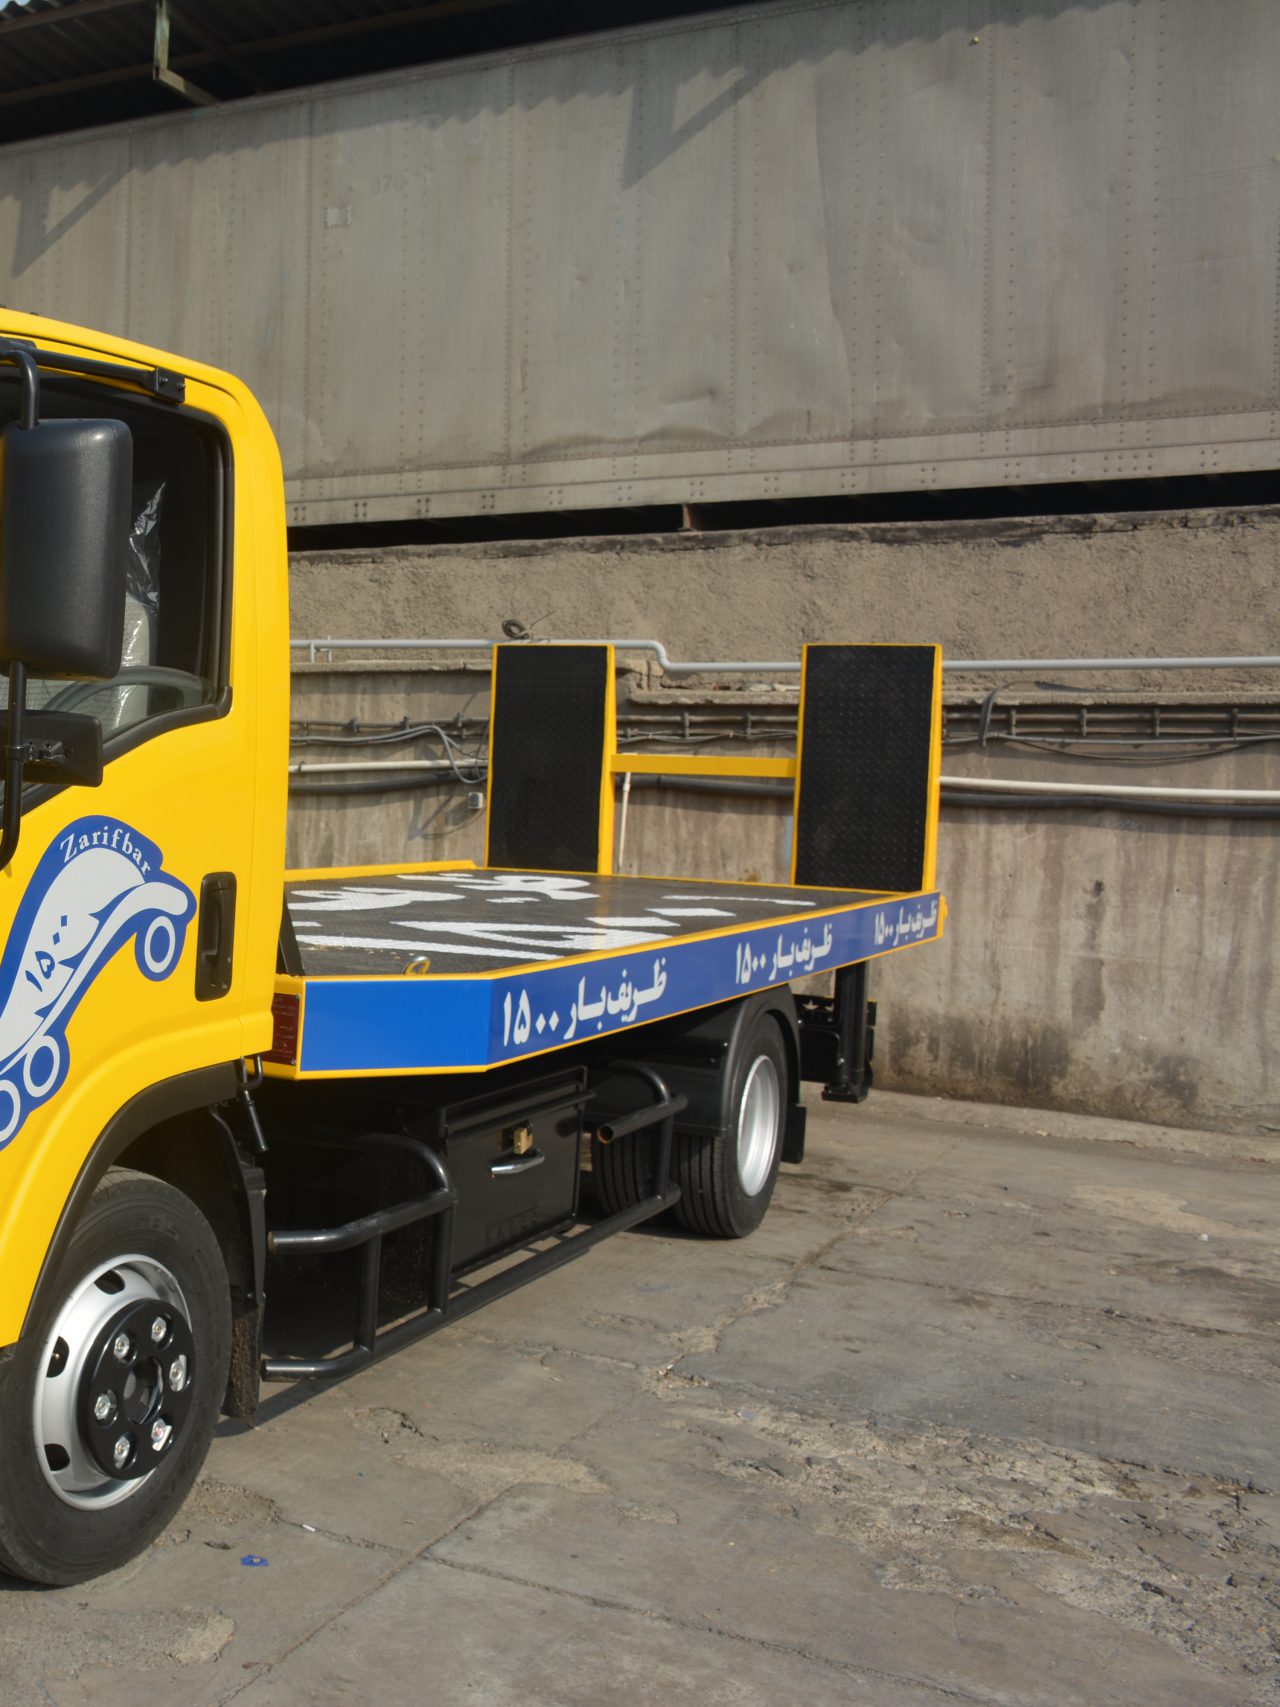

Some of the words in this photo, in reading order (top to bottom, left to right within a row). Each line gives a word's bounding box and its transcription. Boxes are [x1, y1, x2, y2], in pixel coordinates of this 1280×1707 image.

[60, 825, 151, 876] Zarifbar
[25, 914, 69, 993] ۱۵۰۰
[874, 911, 893, 946] ۱۵۰۰
[735, 942, 767, 984] ۱۵۰۰
[503, 989, 560, 1046] ۱۵۰۰
